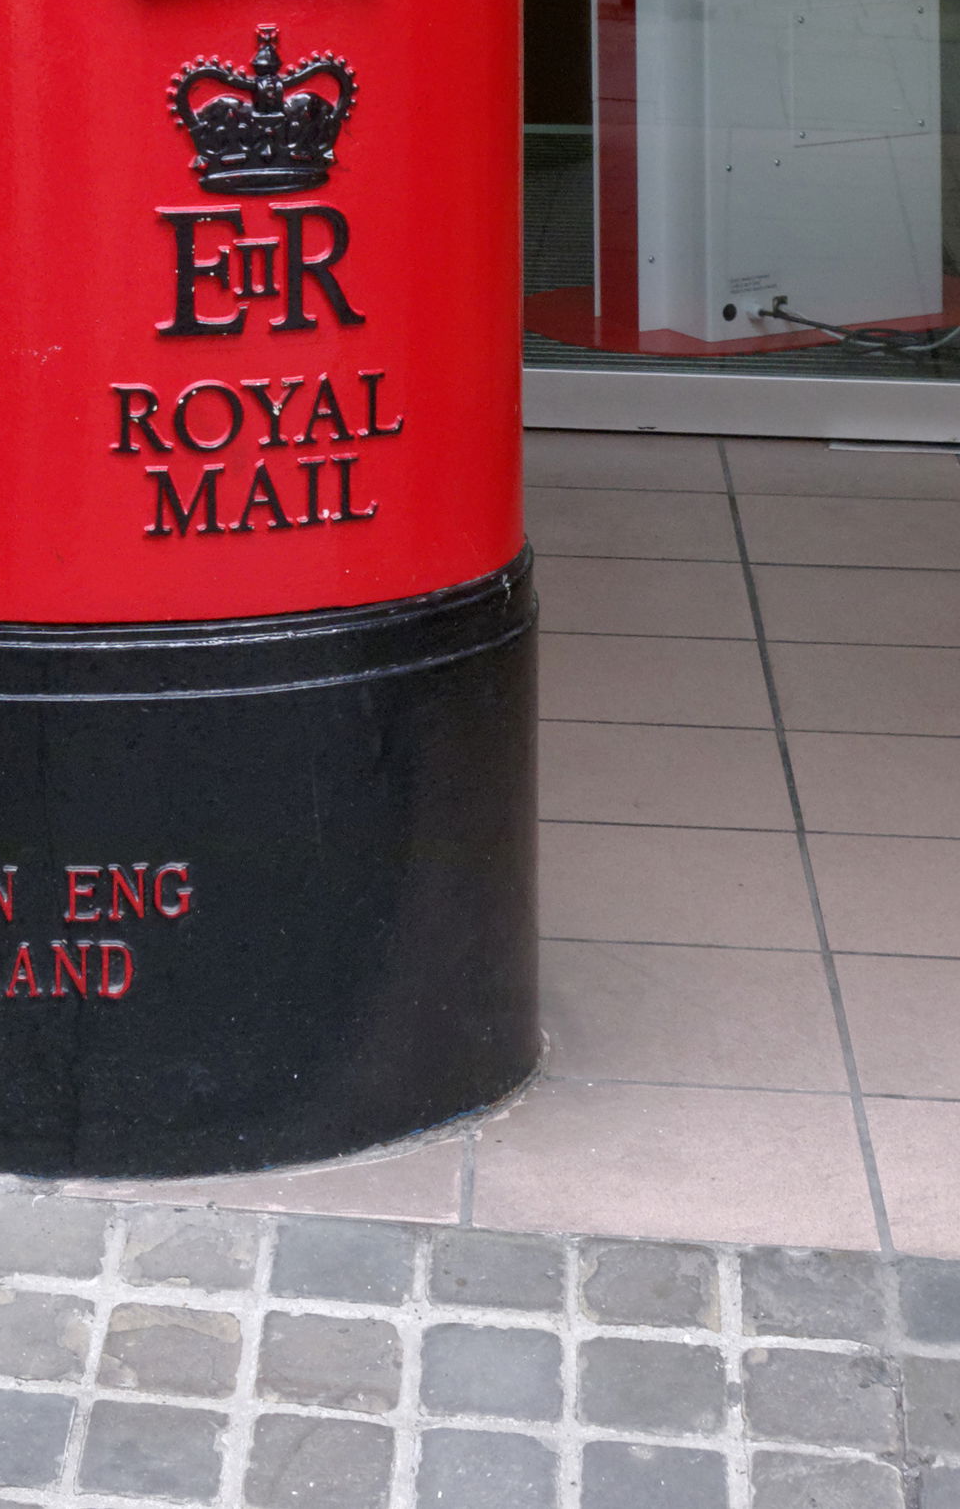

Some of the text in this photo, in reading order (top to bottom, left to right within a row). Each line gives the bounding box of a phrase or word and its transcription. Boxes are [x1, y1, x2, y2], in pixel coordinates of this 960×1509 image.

[108, 368, 404, 455] ROYAL
[145, 452, 380, 537] MAIL
[63, 861, 194, 923] ENG
